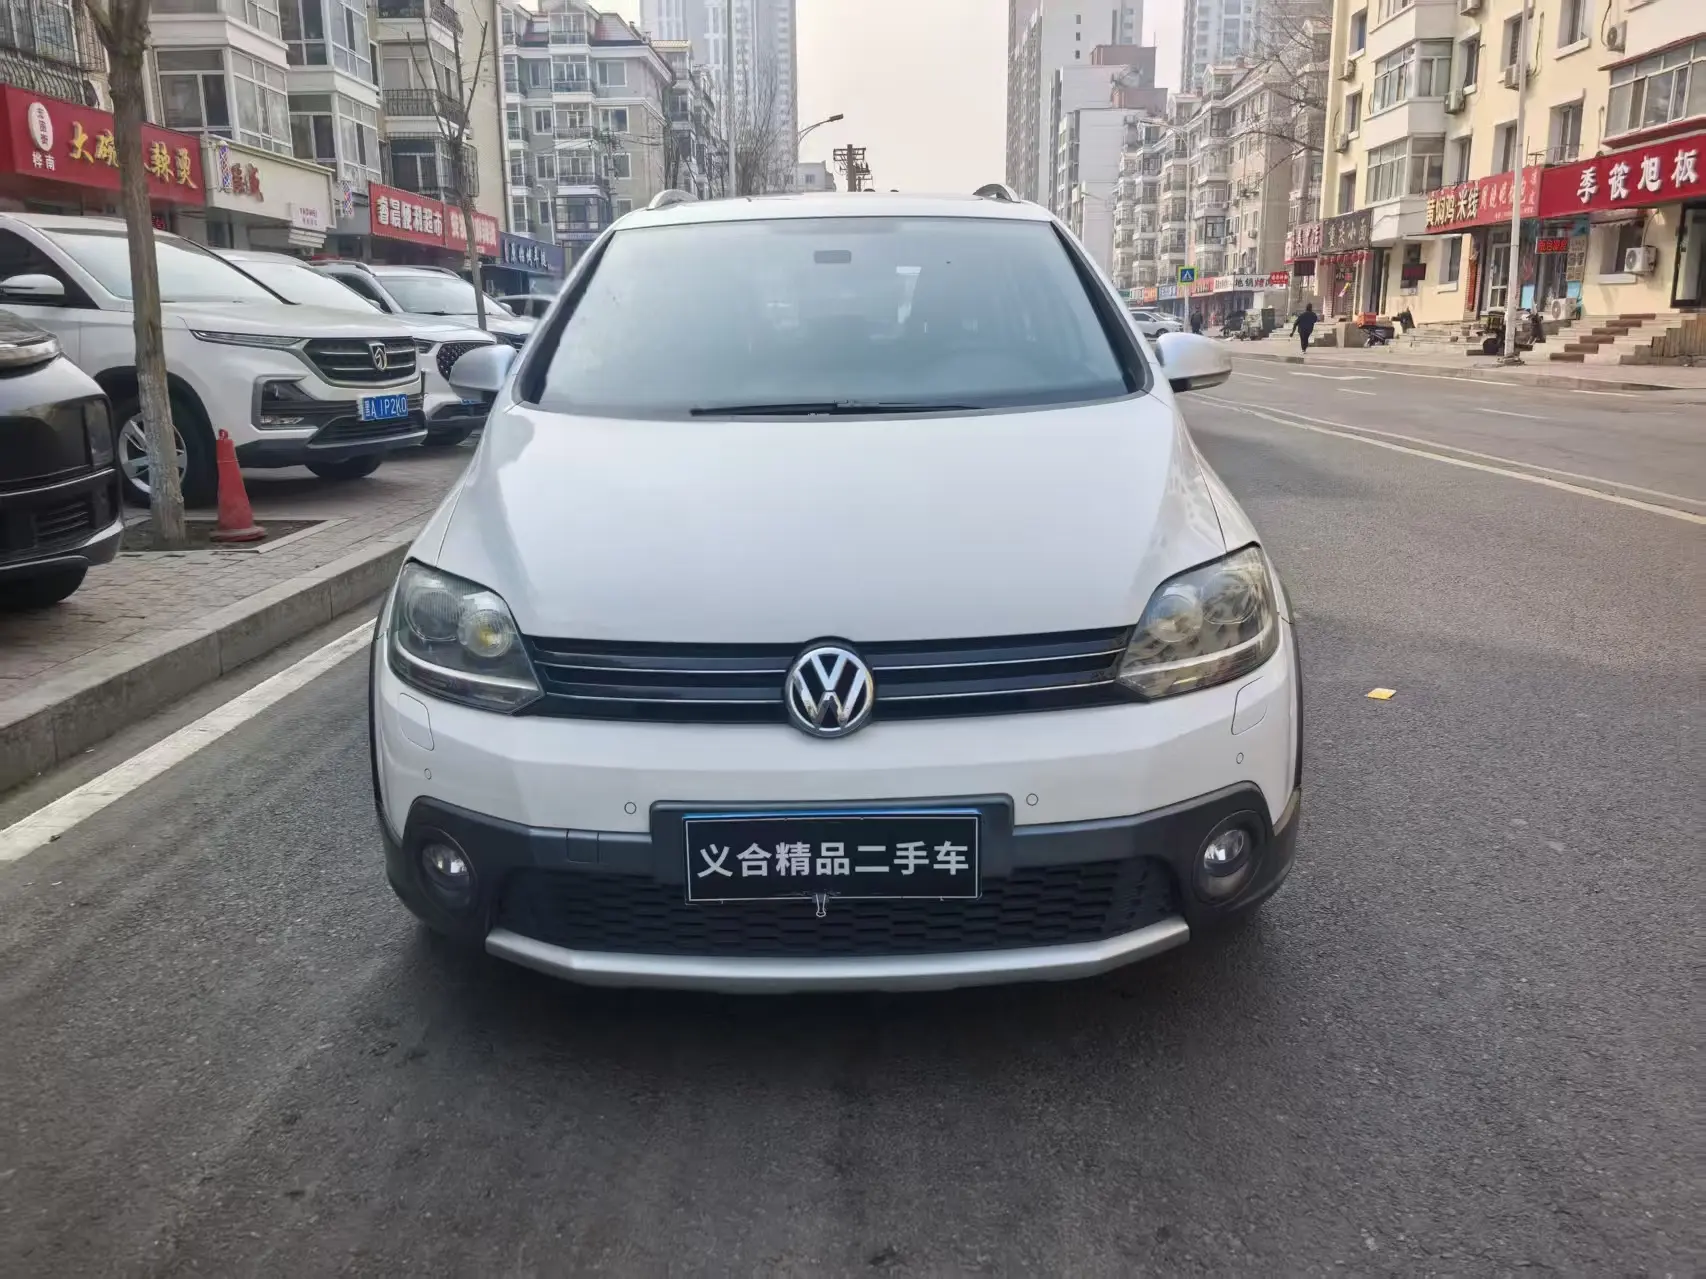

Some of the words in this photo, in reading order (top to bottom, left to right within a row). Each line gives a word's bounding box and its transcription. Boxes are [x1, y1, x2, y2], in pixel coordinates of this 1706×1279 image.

[1427, 187, 1480, 226] 黄焖鸡米线
[697, 841, 969, 878] 义合精品二手车
